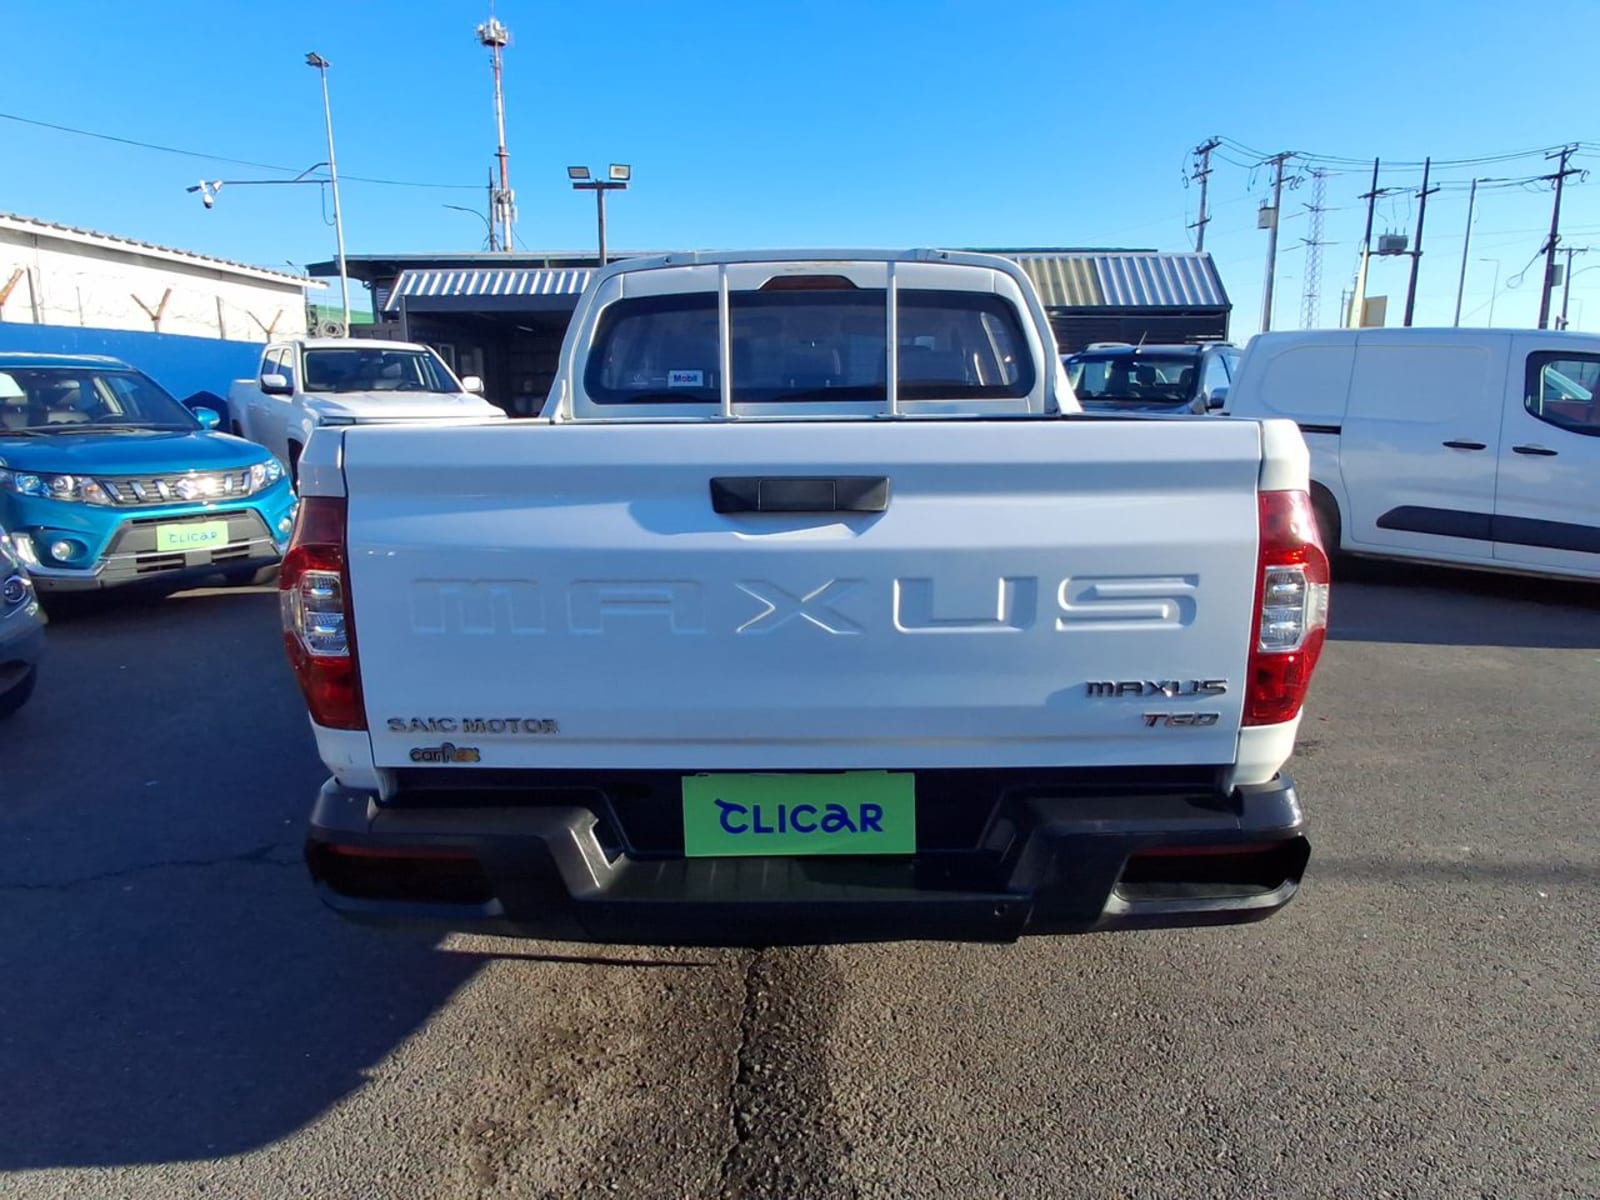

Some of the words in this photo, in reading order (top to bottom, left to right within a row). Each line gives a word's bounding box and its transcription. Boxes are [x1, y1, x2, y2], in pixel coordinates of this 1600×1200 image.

[673, 373, 698, 383] Mobil
[408, 576, 1199, 635] MAXUS
[1085, 679, 1229, 699] MAXUS
[387, 717, 457, 733] SAIC
[462, 717, 560, 734] MOTOR
[1142, 711, 1221, 728] T60
